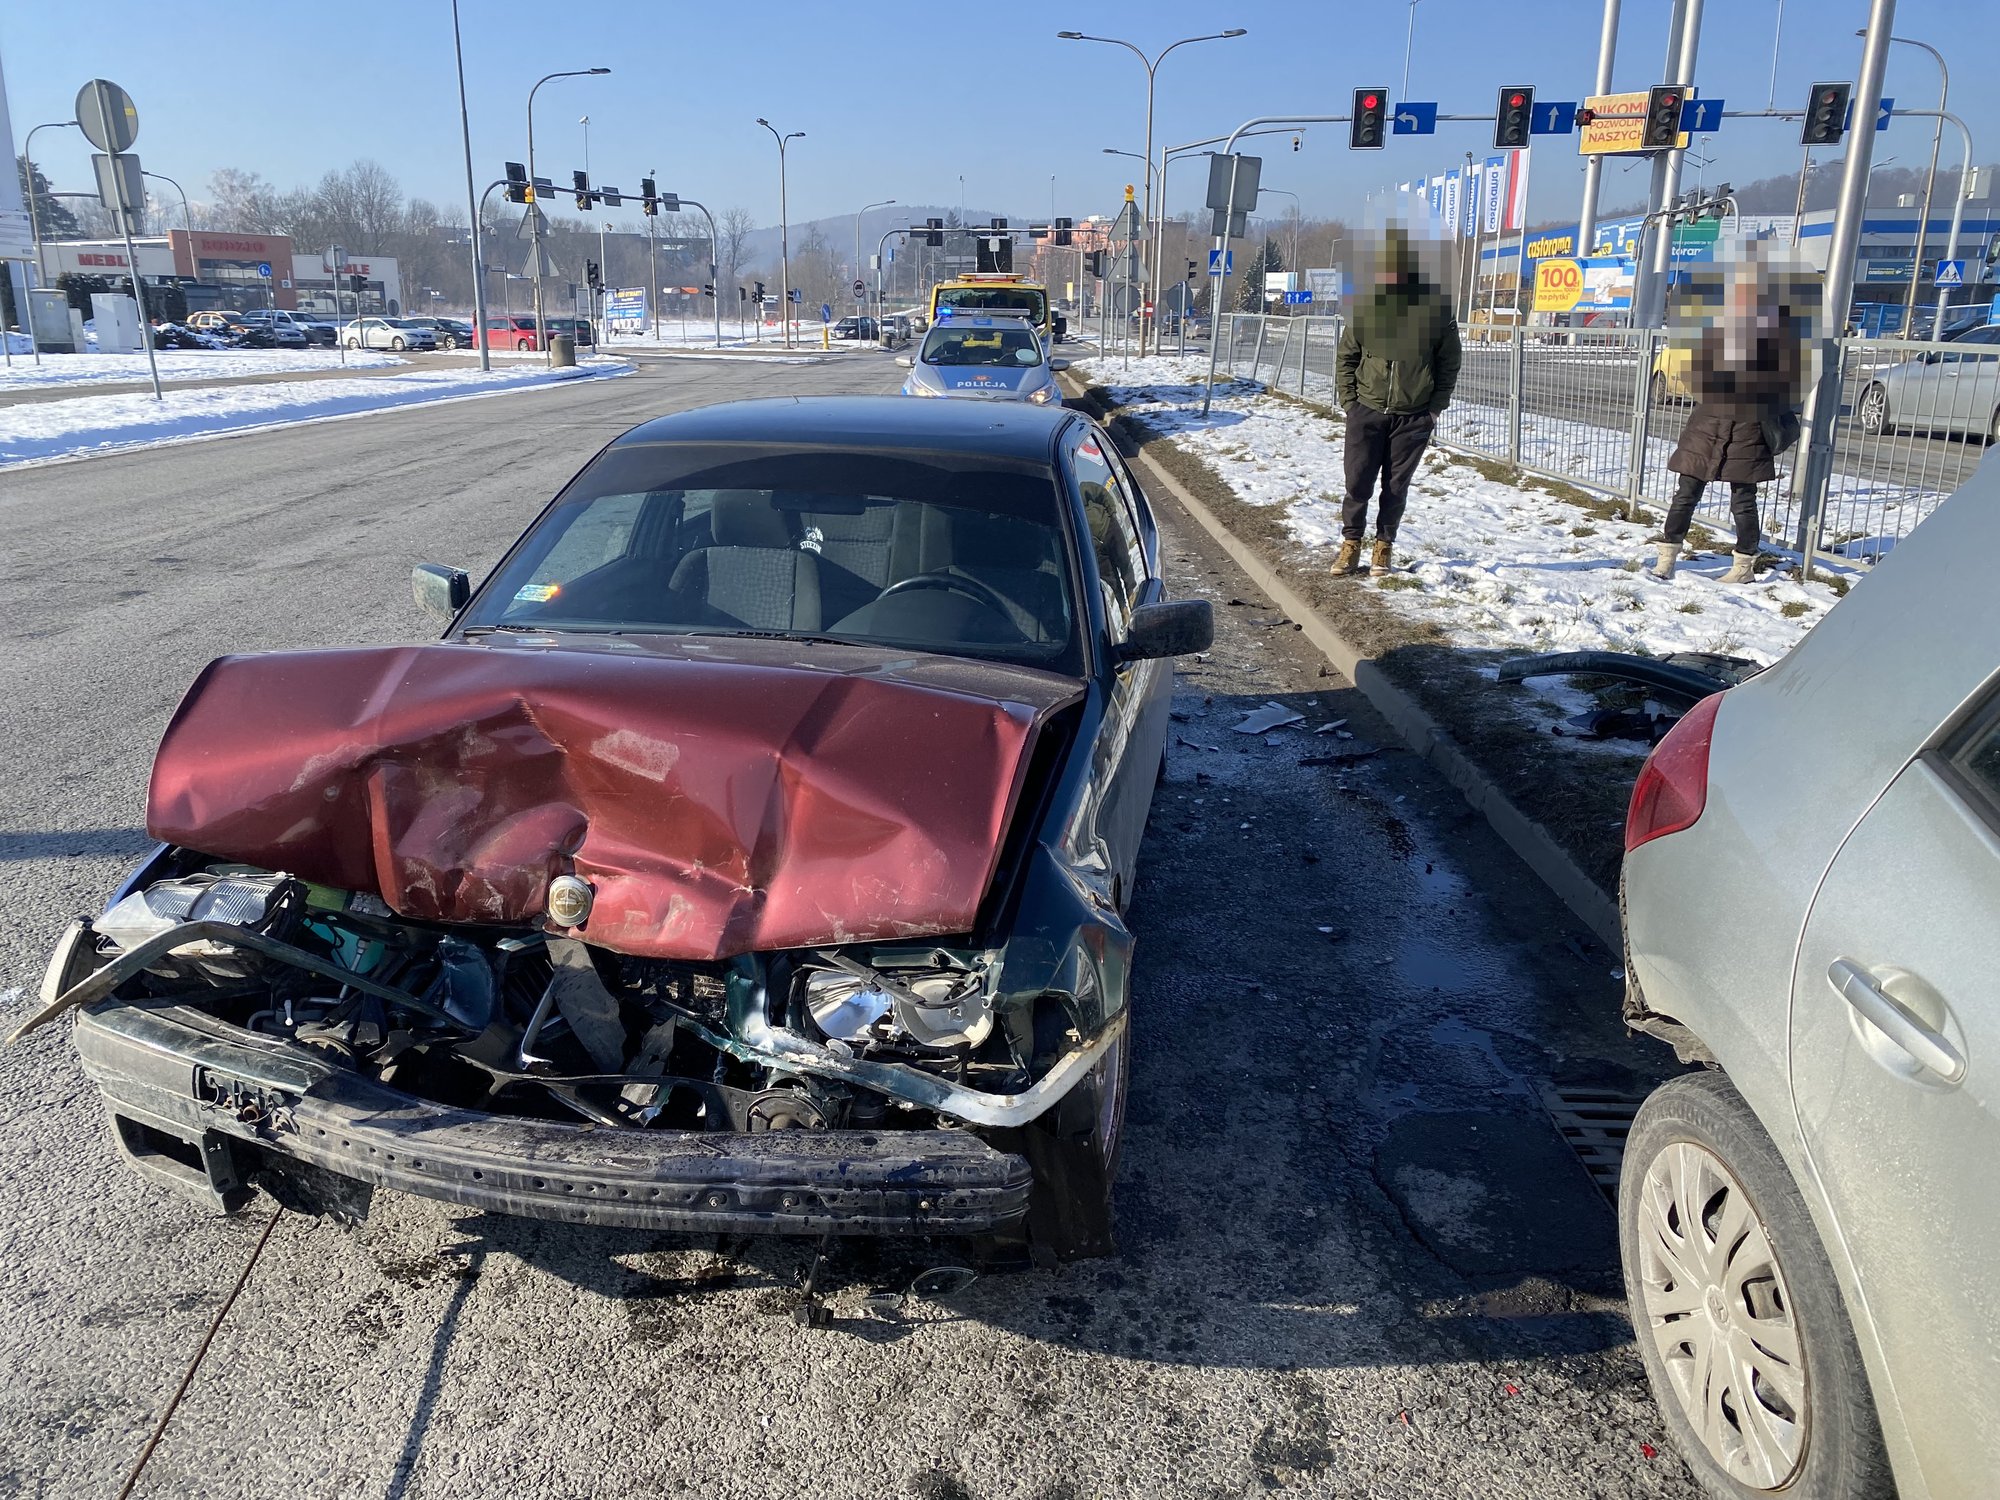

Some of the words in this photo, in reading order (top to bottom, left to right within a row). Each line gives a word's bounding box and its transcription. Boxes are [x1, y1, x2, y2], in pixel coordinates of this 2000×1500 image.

[1591, 101, 1648, 114] NIKOM
[1590, 119, 1643, 130] POZWOLIM
[1527, 236, 1572, 258] castorama
[1541, 267, 1577, 288] 100
[957, 381, 1007, 389] POLICJA
